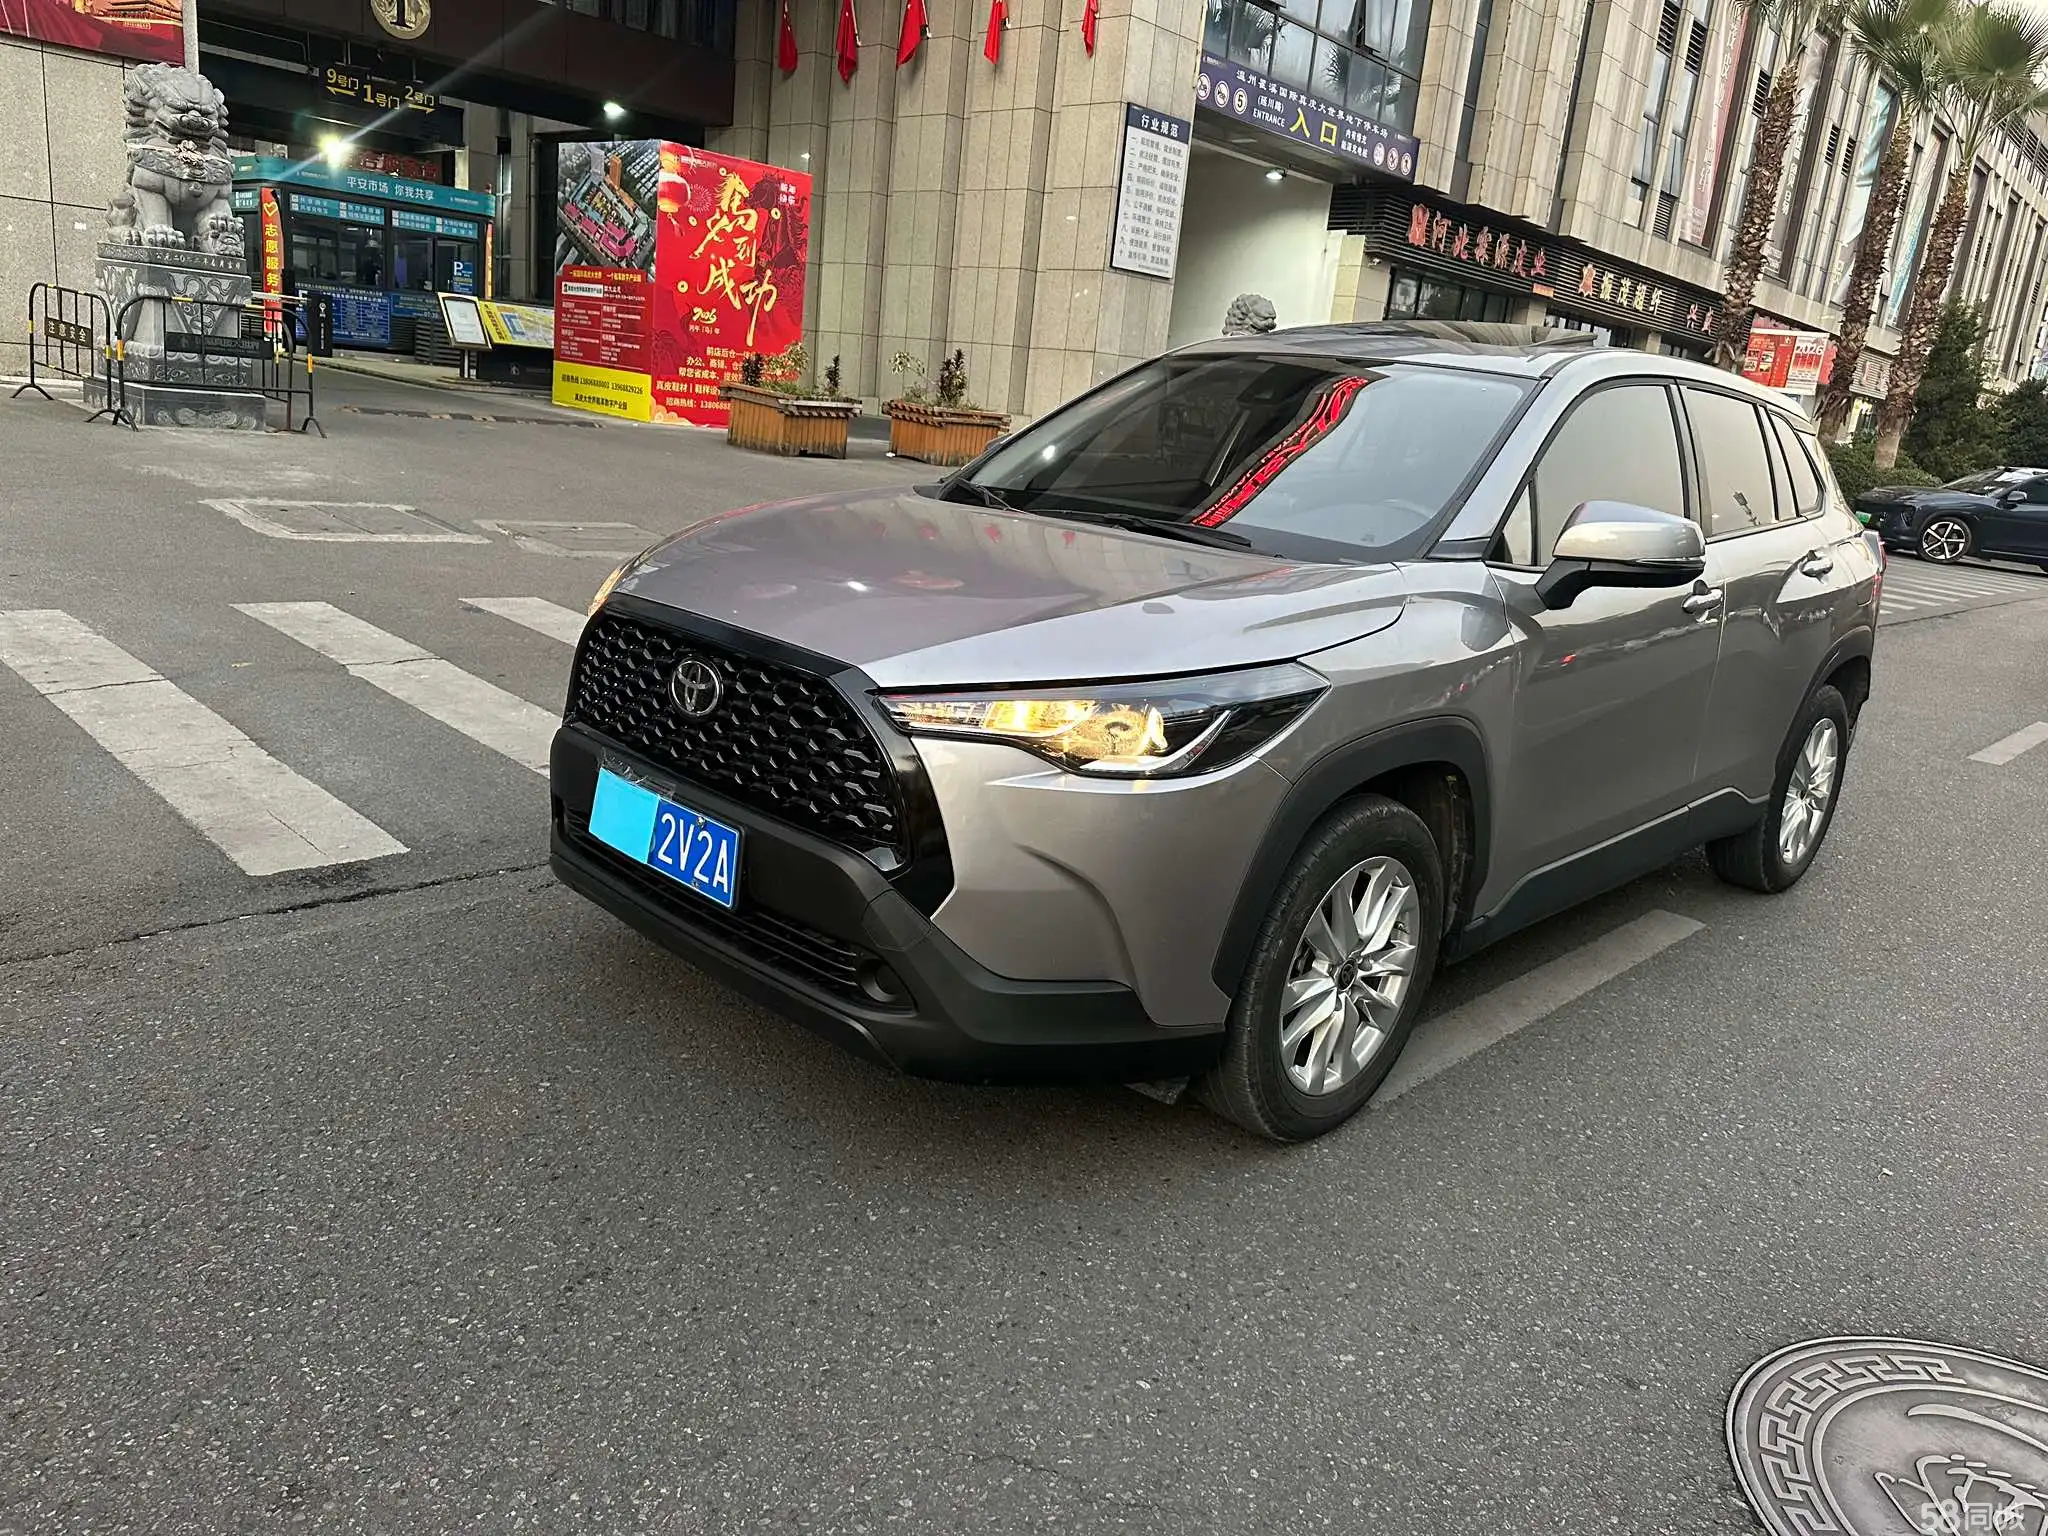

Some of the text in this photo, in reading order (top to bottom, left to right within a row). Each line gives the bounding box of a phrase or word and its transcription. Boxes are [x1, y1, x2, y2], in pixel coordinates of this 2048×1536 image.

[326, 68, 359, 90] 9号门
[363, 84, 400, 110] 1号门
[404, 85, 434, 106] 2号门
[1141, 114, 1180, 138] 行业规范
[1252, 107, 1286, 127] ENTRANCE
[1289, 107, 1338, 146] 入口
[347, 176, 435, 200] 平安市场 你我共享
[454, 261, 464, 276] P
[48, 320, 86, 343] 注意安全
[1795, 343, 1824, 355] 2026
[657, 812, 729, 894] 2V2A
